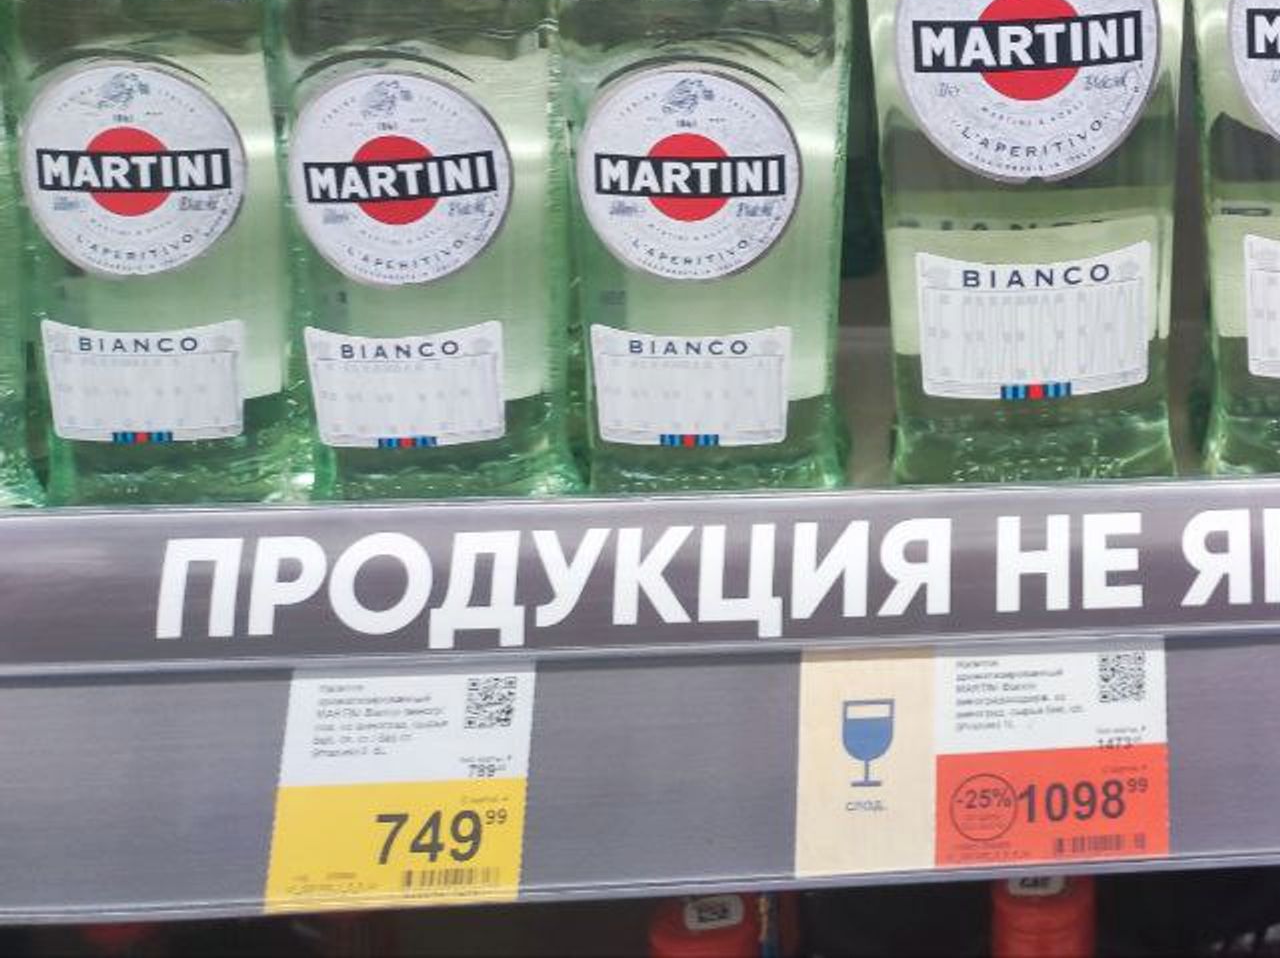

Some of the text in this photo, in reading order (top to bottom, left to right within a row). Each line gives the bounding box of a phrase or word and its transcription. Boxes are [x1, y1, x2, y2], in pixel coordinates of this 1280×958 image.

[919, 17, 1135, 68] MARTINI
[41, 153, 225, 189] MARTINI
[308, 155, 491, 200] MARTINI
[600, 157, 780, 194] MARTINI
[963, 263, 1111, 290] BIANCO
[79, 336, 199, 354] BIANCO
[340, 340, 460, 360] BIANCO
[628, 340, 748, 356] BIANCO
[155, 518, 951, 650] ПРОДУКЦИЯ
[995, 511, 1143, 612] НЕ
[955, 778, 1149, 824] -25% 1098 99
[375, 808, 508, 866] 749 99
